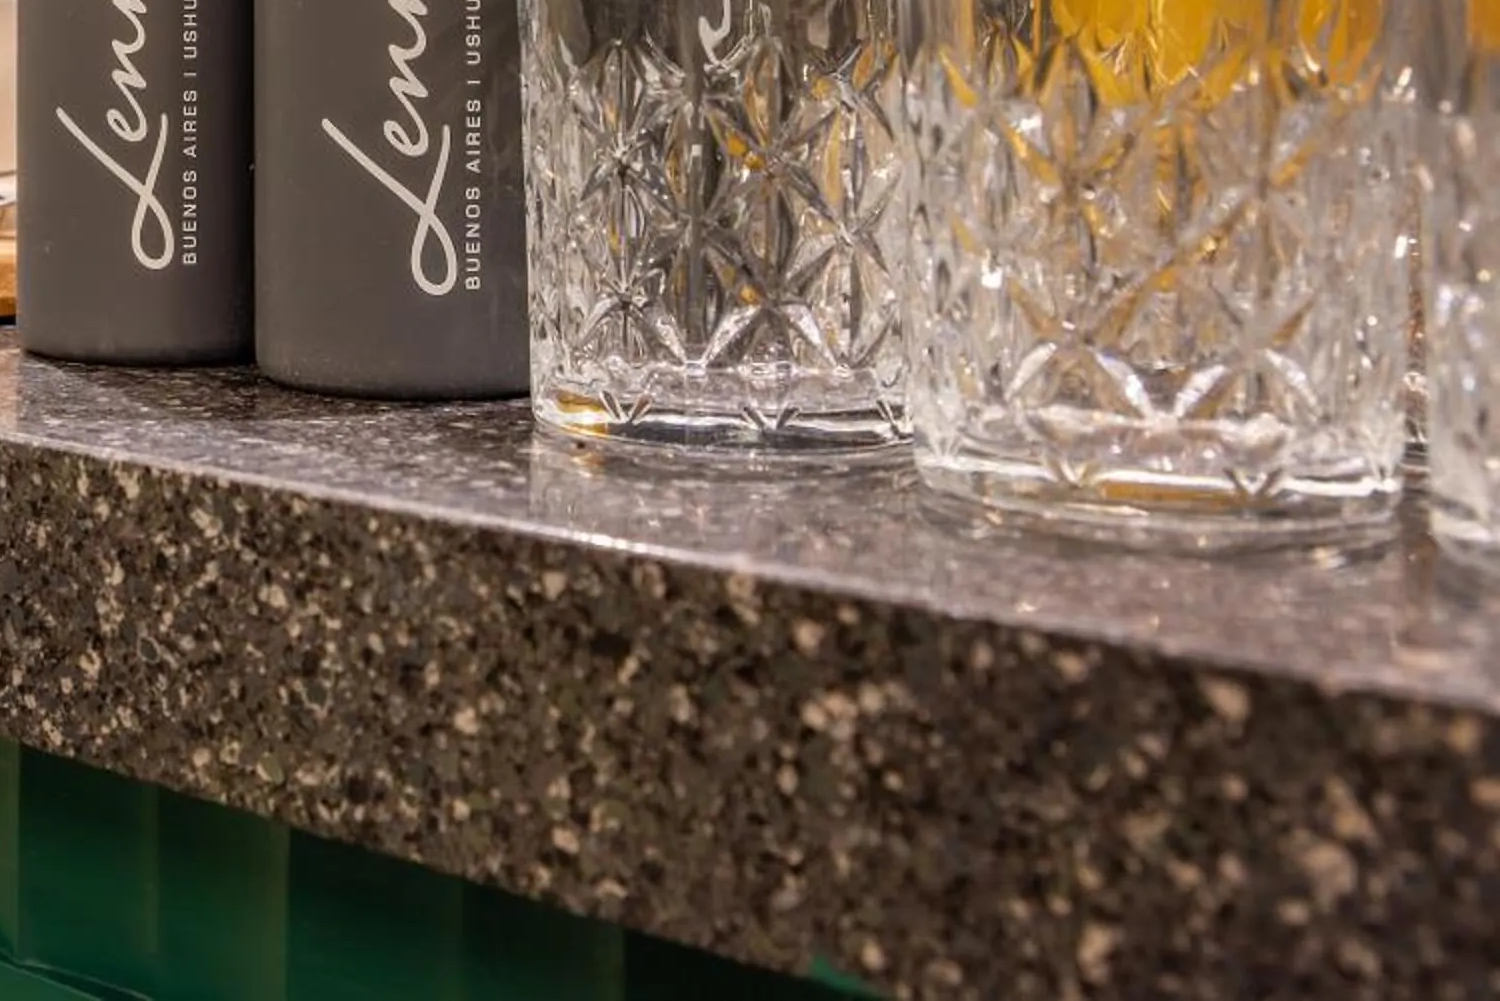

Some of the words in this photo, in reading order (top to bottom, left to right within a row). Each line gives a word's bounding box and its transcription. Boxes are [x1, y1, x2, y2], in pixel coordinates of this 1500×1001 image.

[182, 89, 198, 159] AIRES
[465, 99, 483, 174] AIRES
[182, 170, 198, 266] BUENOS
[464, 186, 482, 290] BUENOS
